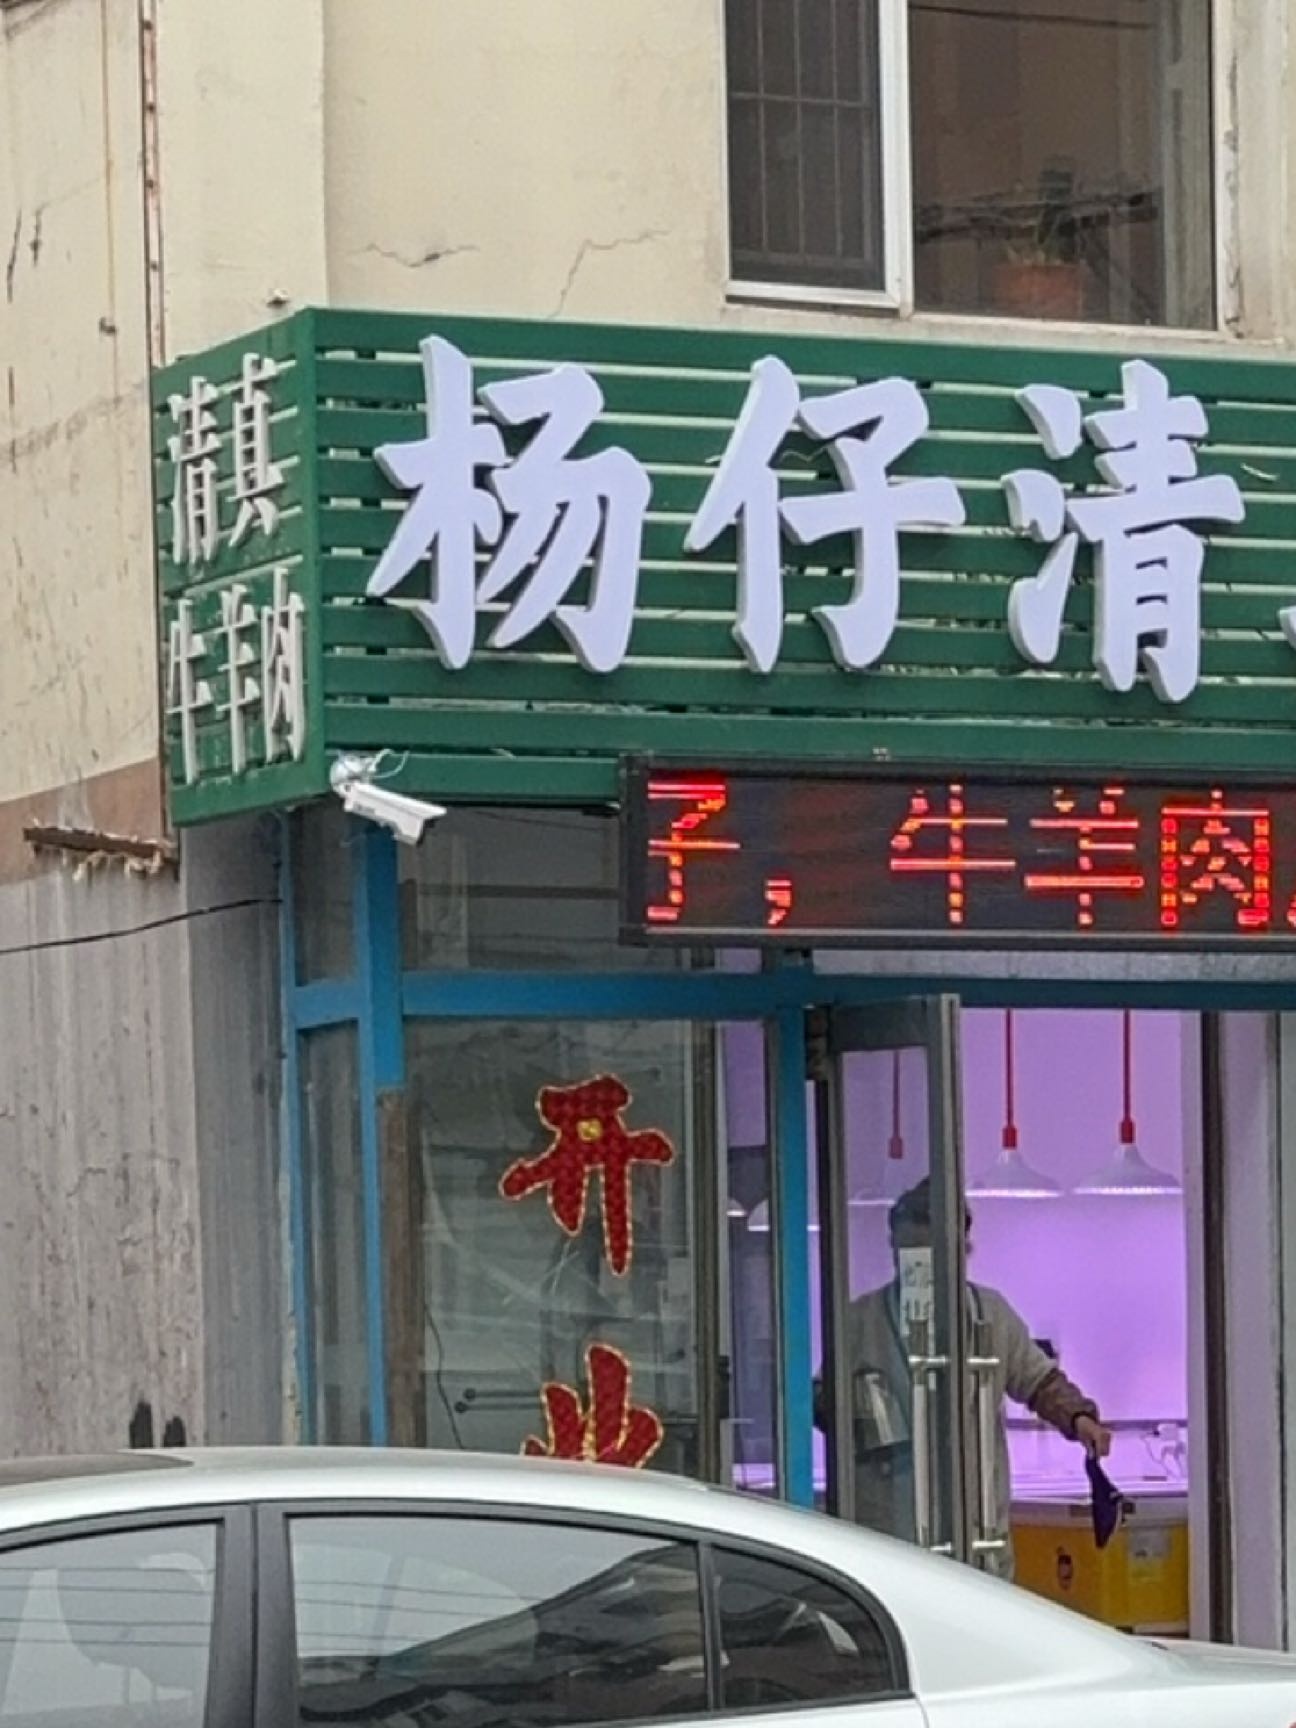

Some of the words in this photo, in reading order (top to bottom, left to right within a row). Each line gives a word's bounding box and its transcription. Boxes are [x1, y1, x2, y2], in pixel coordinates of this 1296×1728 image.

[167, 352, 284, 564] 清真
[166, 567, 306, 785] 牛羊肉
